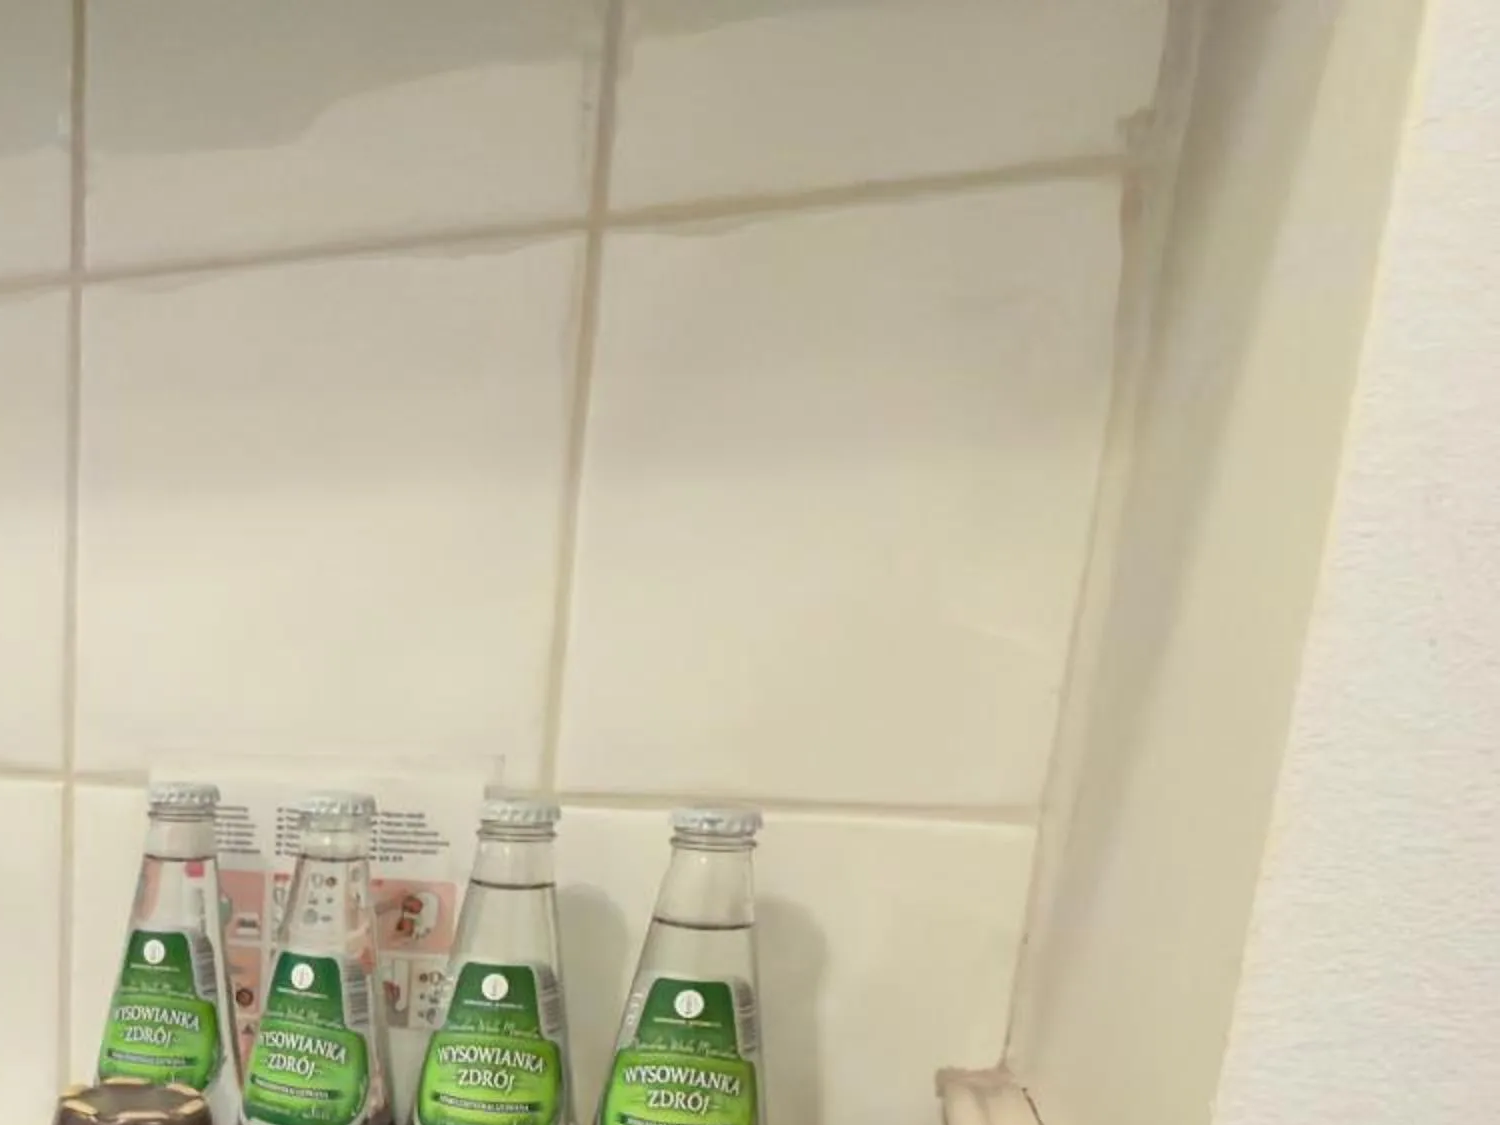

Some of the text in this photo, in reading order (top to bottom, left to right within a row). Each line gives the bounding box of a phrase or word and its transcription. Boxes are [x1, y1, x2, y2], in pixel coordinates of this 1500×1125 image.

[125, 1024, 174, 1049] ZDRÓJ
[260, 1030, 347, 1065] YSOWIANKA
[267, 1052, 315, 1081] ZDRÓJ
[438, 1044, 546, 1074] WYSOWIANKA
[457, 1067, 515, 1094] ZDRÓJ
[624, 1065, 742, 1097] WYSOWIANKA
[647, 1089, 711, 1116] ZDRÓJ
